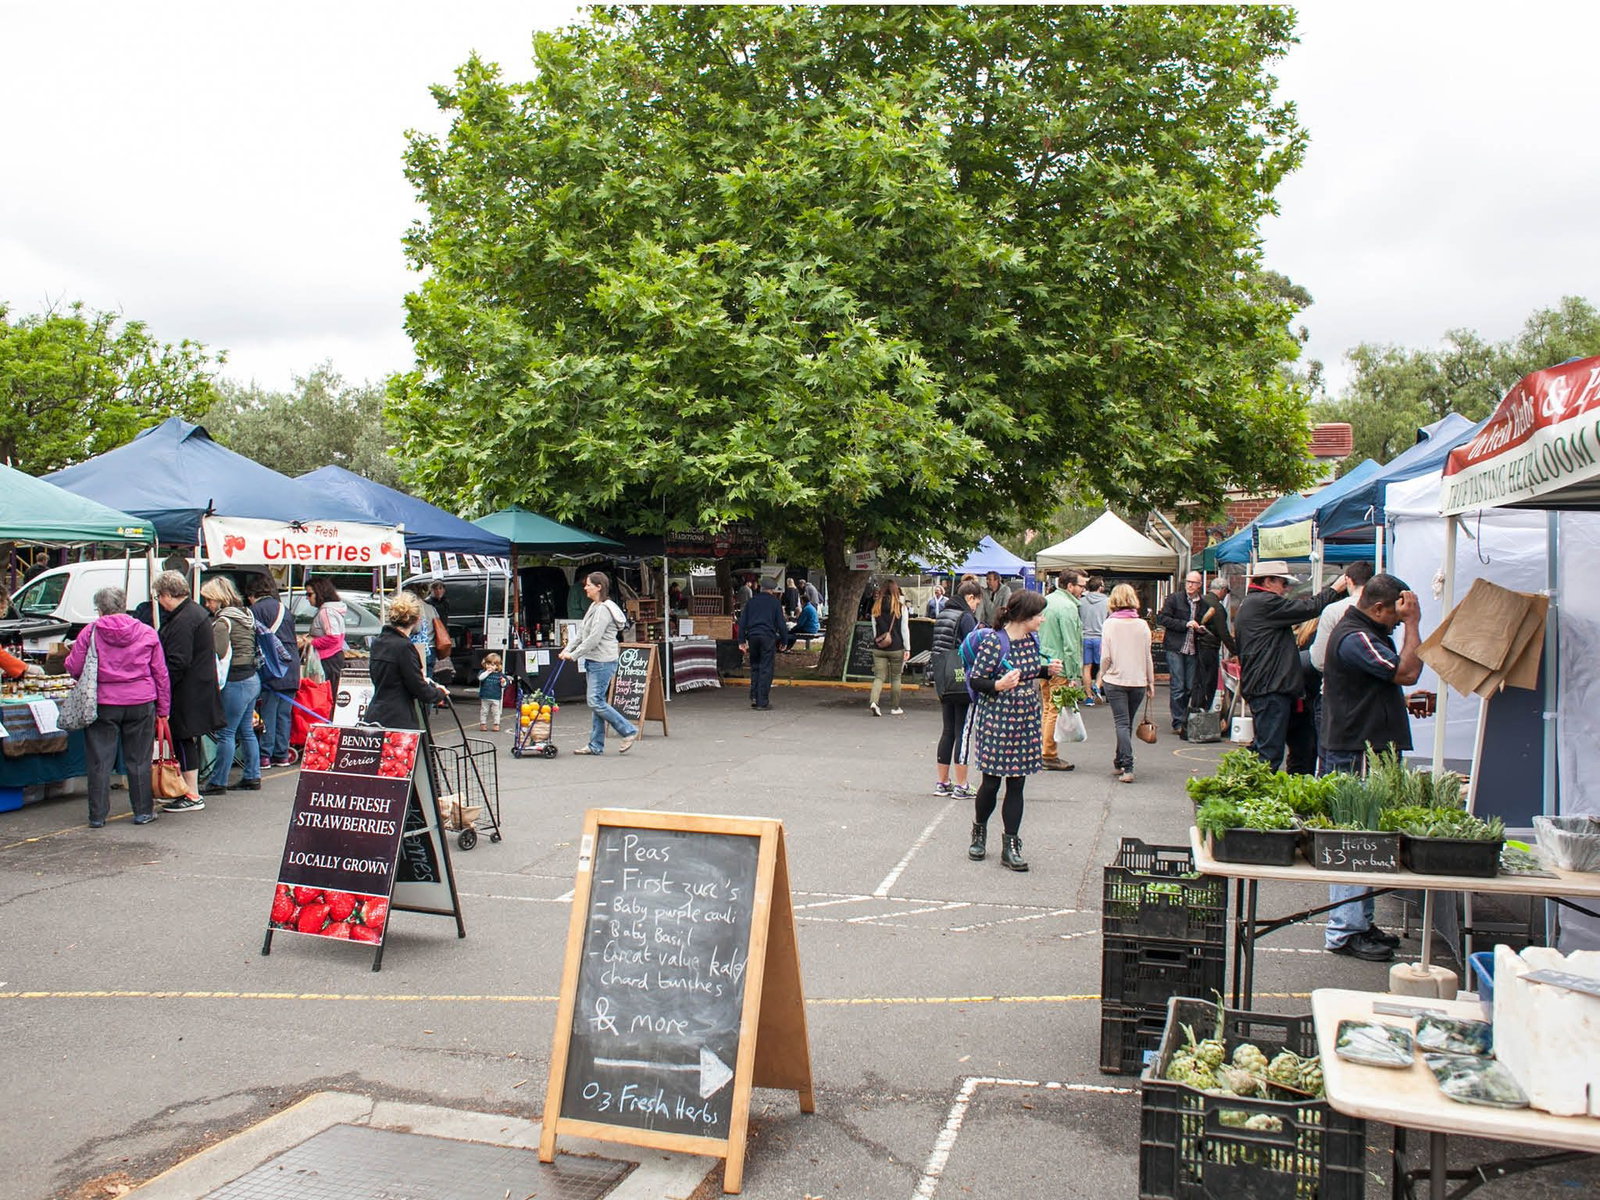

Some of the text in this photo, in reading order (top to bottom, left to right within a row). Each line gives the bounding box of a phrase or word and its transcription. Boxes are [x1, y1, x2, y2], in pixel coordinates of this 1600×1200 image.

[1542, 374, 1571, 417] &
[1447, 480, 1469, 510] TRUE
[1468, 464, 1506, 505] TASTING
[1509, 426, 1596, 494] HEIRLOOM
[314, 525, 339, 538] Fresh
[263, 538, 371, 562] Cherries
[341, 735, 381, 749] BENNY'S
[339, 753, 376, 769] Berries
[309, 792, 347, 809] FARM
[348, 796, 391, 814] FRESH
[297, 811, 396, 836] STRAWBERRIES
[623, 834, 671, 863] Peas
[1342, 834, 1378, 851] Herbs
[288, 851, 389, 875] LOCALLY GROWN
[1321, 847, 1396, 872] $3 per bunch
[622, 868, 675, 894] First
[613, 896, 648, 923] Baby
[655, 903, 701, 925] purple
[704, 906, 737, 924] cauli
[609, 920, 647, 946] Baby
[655, 927, 693, 947] Basil
[603, 940, 652, 965] Great
[658, 946, 700, 970] value
[619, 1084, 669, 1119] Fresh
[675, 1095, 718, 1124] Herbs
